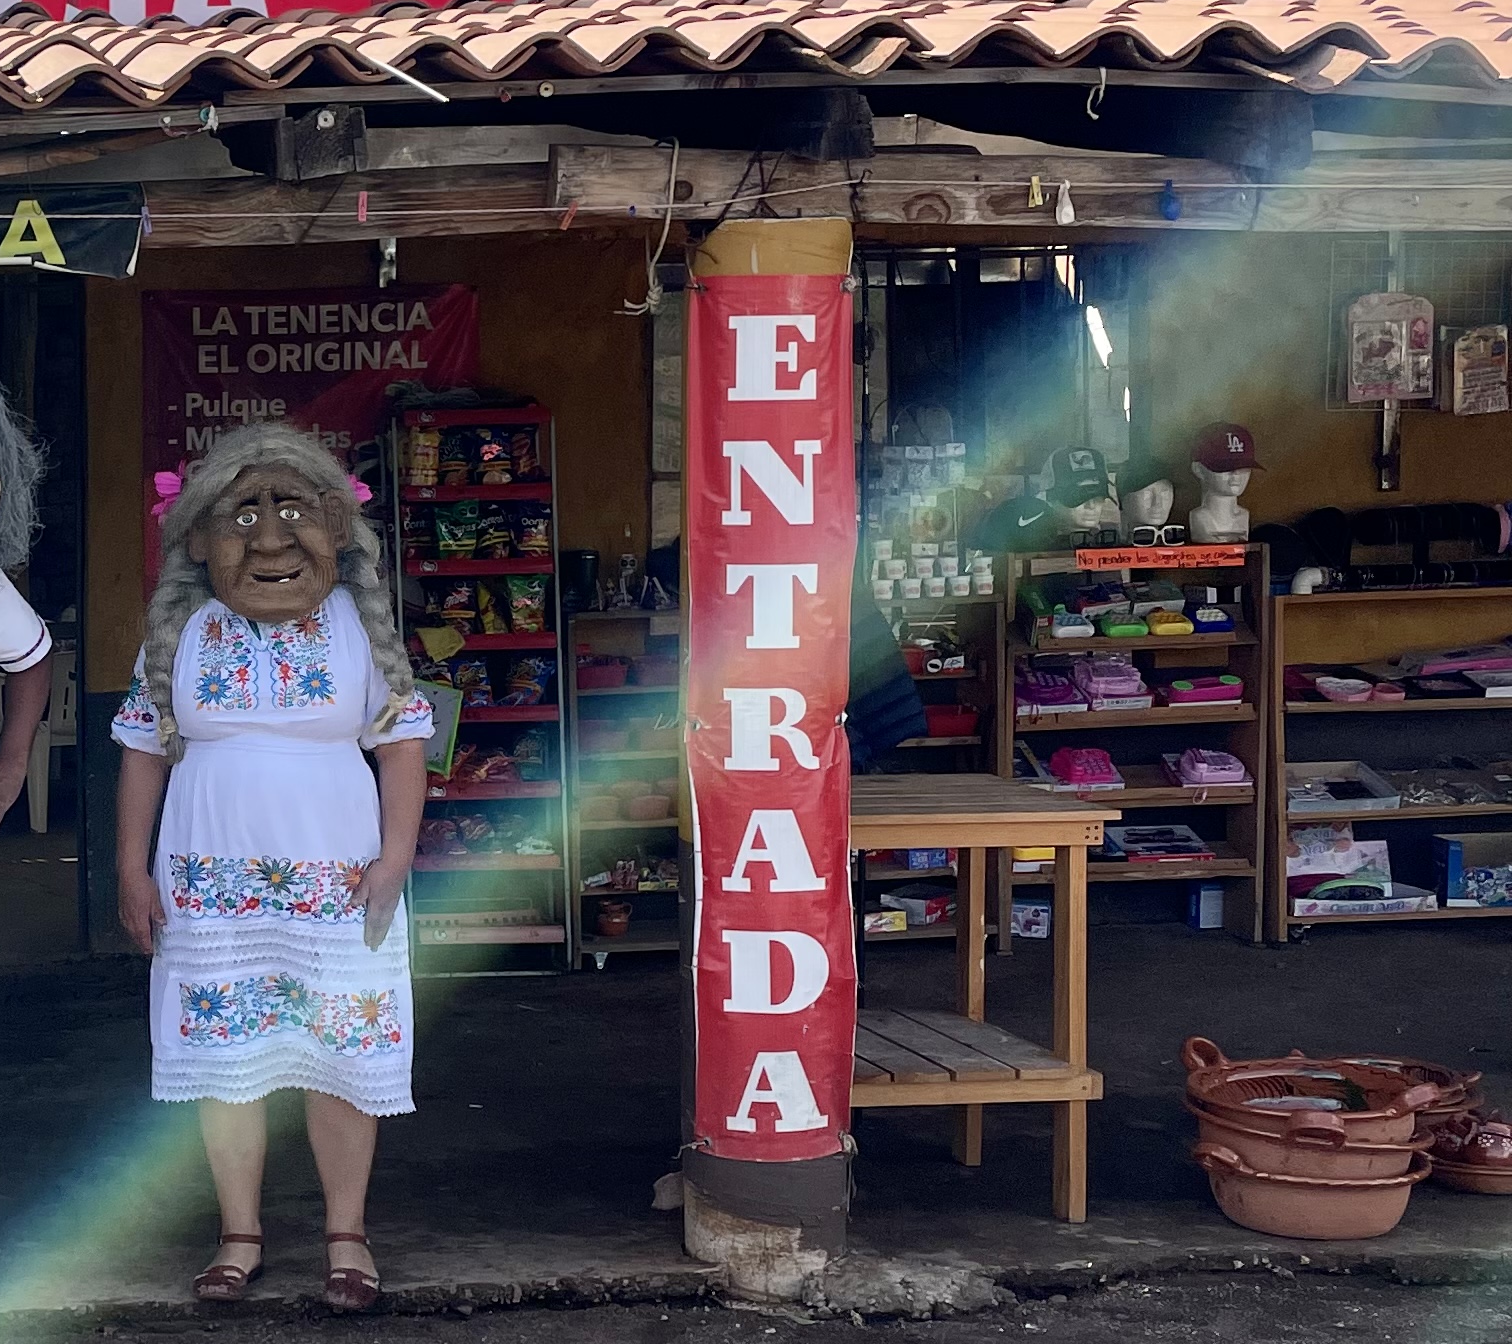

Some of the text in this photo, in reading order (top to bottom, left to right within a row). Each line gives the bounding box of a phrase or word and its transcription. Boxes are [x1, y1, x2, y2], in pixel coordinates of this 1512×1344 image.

[192, 301, 433, 336] LA TENENCIA
[197, 340, 428, 374] EL ORIGINAL
[186, 392, 286, 423] Pulque
[1226, 432, 1244, 453] LA
[1078, 552, 1093, 566] No
[722, 314, 829, 1133] ENTRADA
